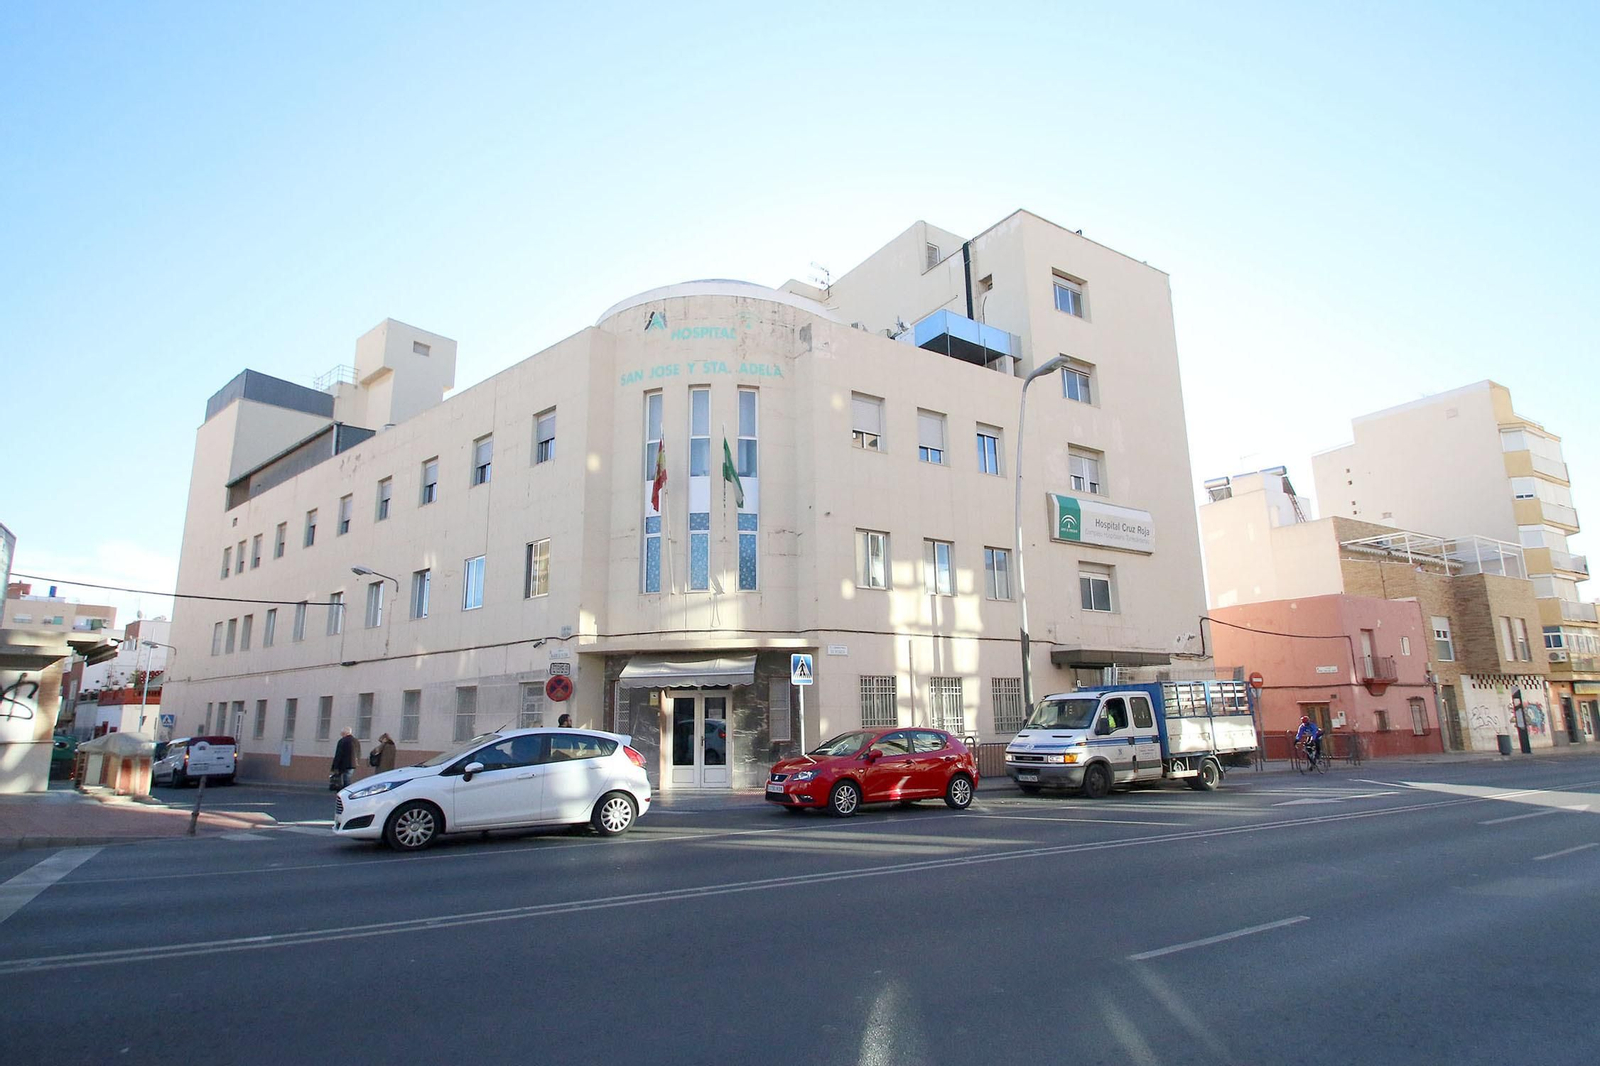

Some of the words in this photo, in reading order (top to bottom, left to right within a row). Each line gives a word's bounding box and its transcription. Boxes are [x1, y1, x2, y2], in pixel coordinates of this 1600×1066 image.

[671, 326, 736, 341] HOSPITAL
[621, 370, 643, 386] SAN
[649, 363, 679, 379] JOSE
[687, 363, 695, 374] Y
[703, 362, 731, 374] STA.
[739, 363, 782, 377] ADELA
[1095, 518, 1120, 531] Hospital
[1121, 523, 1136, 533] Cruz
[1137, 526, 1150, 537] Roja
